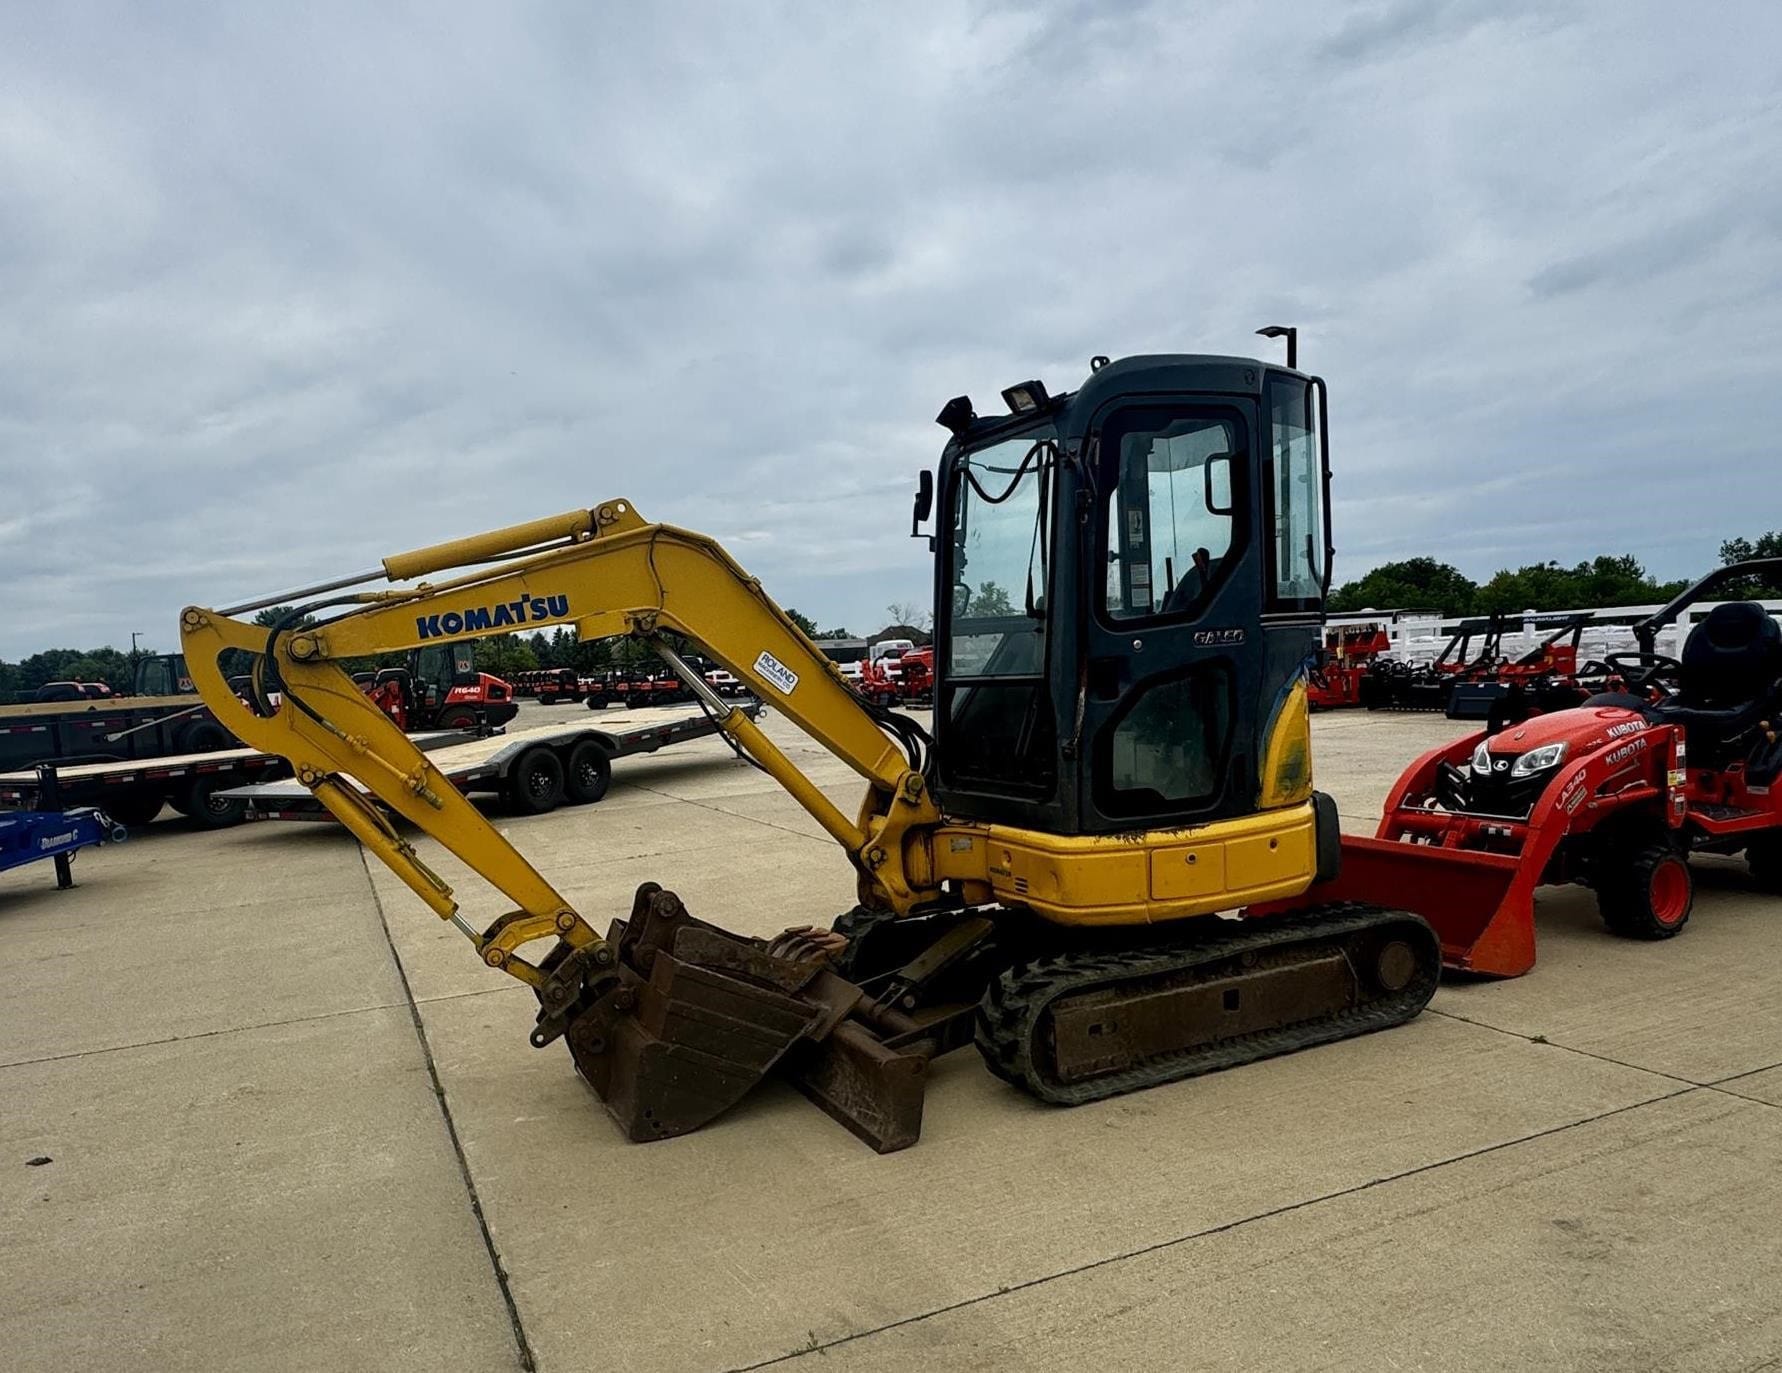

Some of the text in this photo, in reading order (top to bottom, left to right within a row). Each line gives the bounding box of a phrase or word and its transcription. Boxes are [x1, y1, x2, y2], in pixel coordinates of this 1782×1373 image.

[416, 593, 569, 638] KOMATSU
[761, 654, 795, 684] ROLAND
[1606, 720, 1647, 738] KUBOTA
[1605, 738, 1648, 766] KUBOTA
[1555, 768, 1587, 810] LA340
